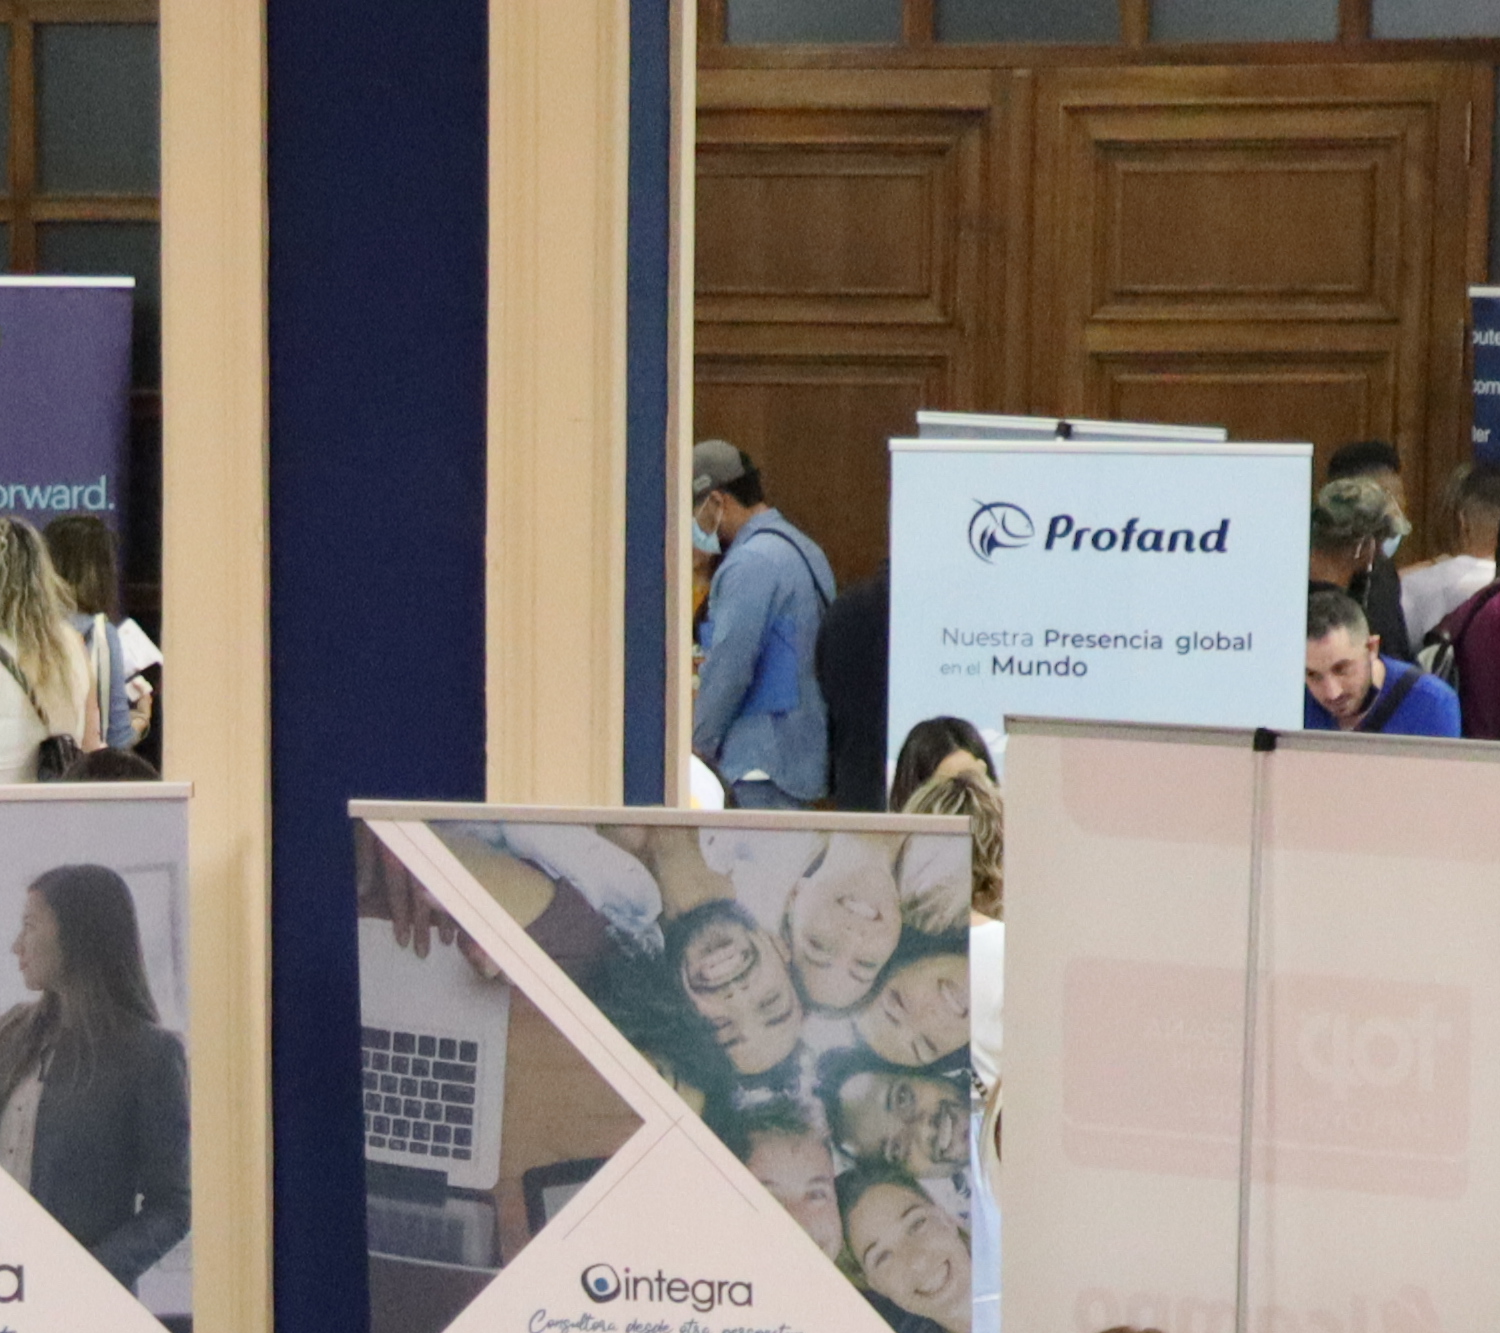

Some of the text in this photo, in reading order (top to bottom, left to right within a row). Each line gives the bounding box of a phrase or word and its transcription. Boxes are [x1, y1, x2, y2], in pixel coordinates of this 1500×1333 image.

[1044, 515, 1230, 553] Profand
[941, 627, 1253, 655] Nuestra Presencia global
[940, 663, 963, 676] en
[991, 655, 1088, 677] Mundo
[624, 1267, 753, 1313] integra
